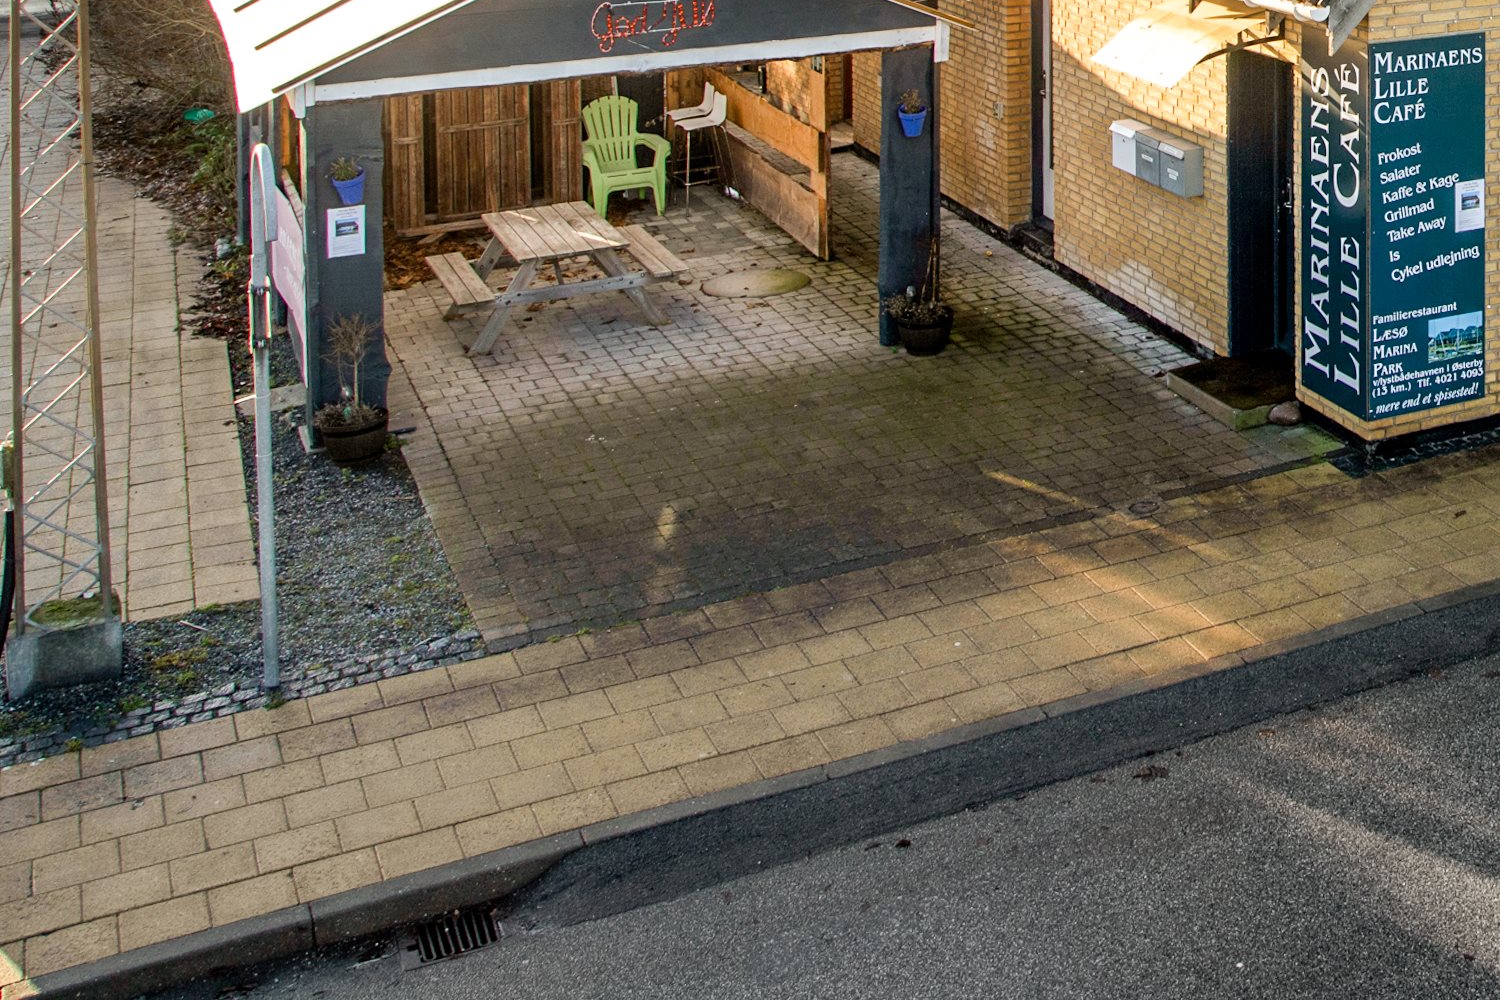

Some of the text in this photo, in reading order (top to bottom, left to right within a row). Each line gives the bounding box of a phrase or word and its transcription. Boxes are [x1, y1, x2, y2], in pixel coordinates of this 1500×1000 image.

[1374, 48, 1482, 74] MARINAENS
[1374, 78, 1429, 99] LILLE
[1374, 99, 1426, 124] CAFÉ
[1378, 142, 1422, 165] Frokost
[1380, 163, 1421, 184] Salater
[1382, 185, 1413, 205] Kaffe
[1416, 182, 1426, 194] &
[1430, 172, 1459, 190] Kage
[1305, 67, 1329, 378] MARINAENS
[1384, 198, 1434, 223] Grillmad
[1334, 63, 1360, 395] LILLE CAFÉ
[1387, 225, 1415, 242] Take
[1418, 216, 1446, 234] Away
[1389, 250, 1400, 262] Is
[1391, 245, 1480, 282] Cykel udlejning
[1372, 302, 1457, 324] Familierestaurant
[1373, 326, 1408, 343] LÆSØ
[1373, 342, 1417, 360] MARINA
[1373, 362, 1403, 378] PARK
[1452, 359, 1483, 372] Østerby
[1372, 368, 1483, 398] (13 km.) Tlf. 4021 4093
[1376, 401, 1400, 414] mere
[1402, 393, 1420, 409] end
[1422, 393, 1432, 404] et
[1434, 382, 1479, 405] spisested!
